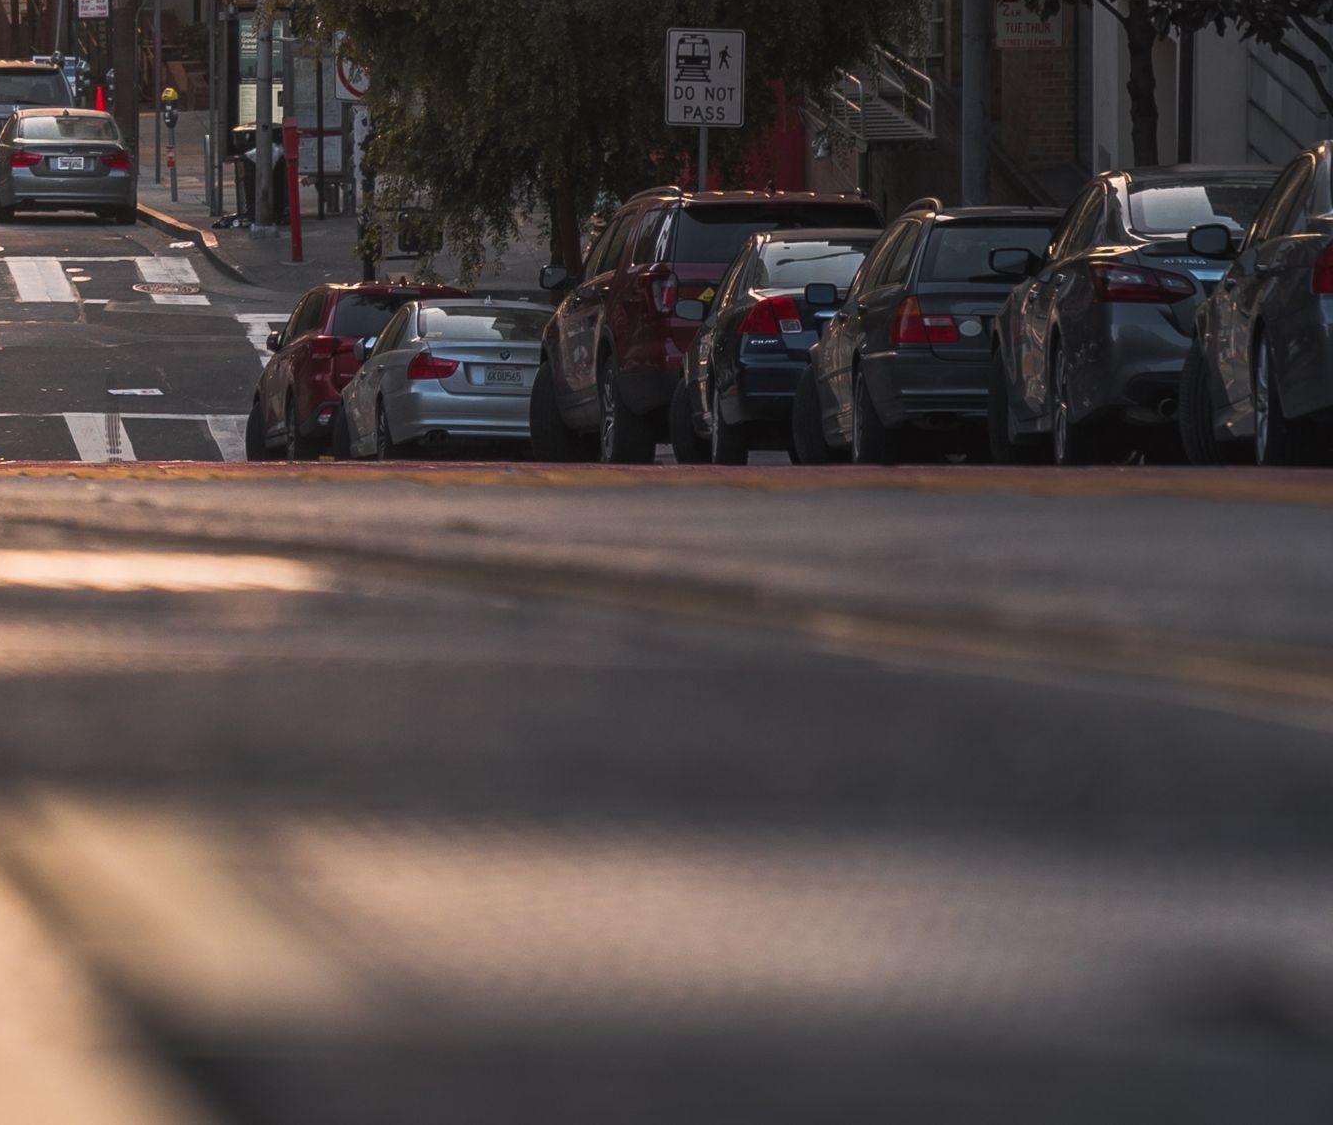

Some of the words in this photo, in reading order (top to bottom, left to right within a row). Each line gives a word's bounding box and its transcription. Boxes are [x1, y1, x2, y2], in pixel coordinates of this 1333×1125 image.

[674, 86, 694, 100] DO
[705, 86, 736, 101] NOT
[683, 106, 726, 121] PASS
